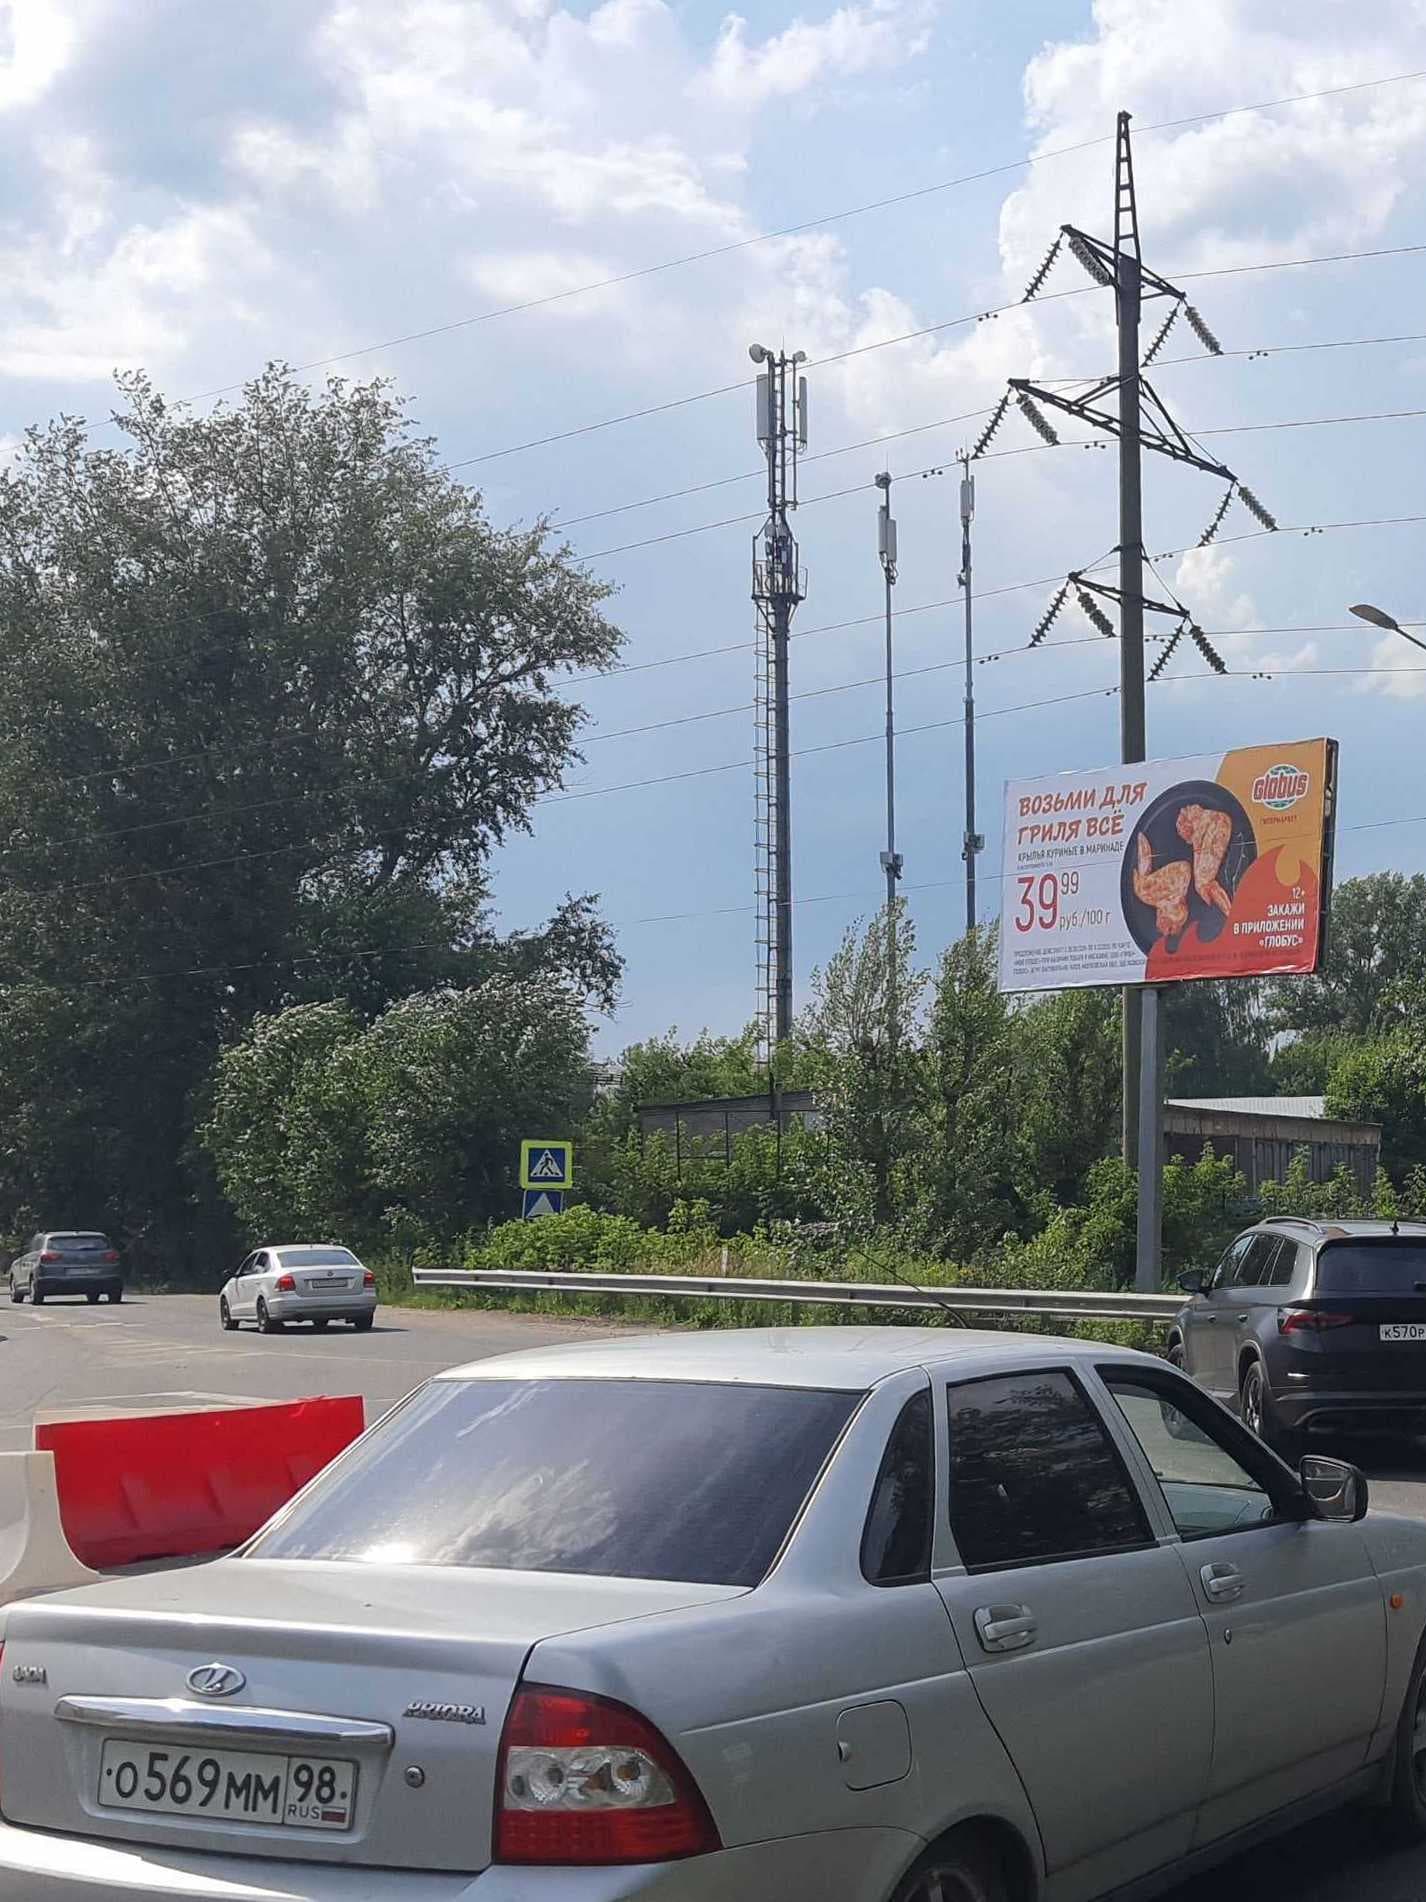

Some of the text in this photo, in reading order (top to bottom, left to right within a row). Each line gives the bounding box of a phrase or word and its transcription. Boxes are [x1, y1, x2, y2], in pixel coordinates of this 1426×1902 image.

[1254, 771, 1307, 800] Globus
[1019, 782, 1147, 816] ВОЗЬМИ ДЛЯ
[1018, 809, 1125, 845] ГРИЛЯ ВСЁ
[1018, 841, 1124, 861] КРЫЛЬЯ КУРИНЫЕ В МАРИНАДЕ
[1015, 871, 1079, 932] 39 99
[1292, 886, 1305, 899] 12+
[1267, 903, 1305, 916] ЗАКАЖИ
[1233, 919, 1304, 934] В ПРИЛОЖЕНИИ
[1259, 935, 1303, 949] «ГЛОБУС»
[293, 1763, 336, 1804] 98
[287, 1804, 320, 1819] RUS
